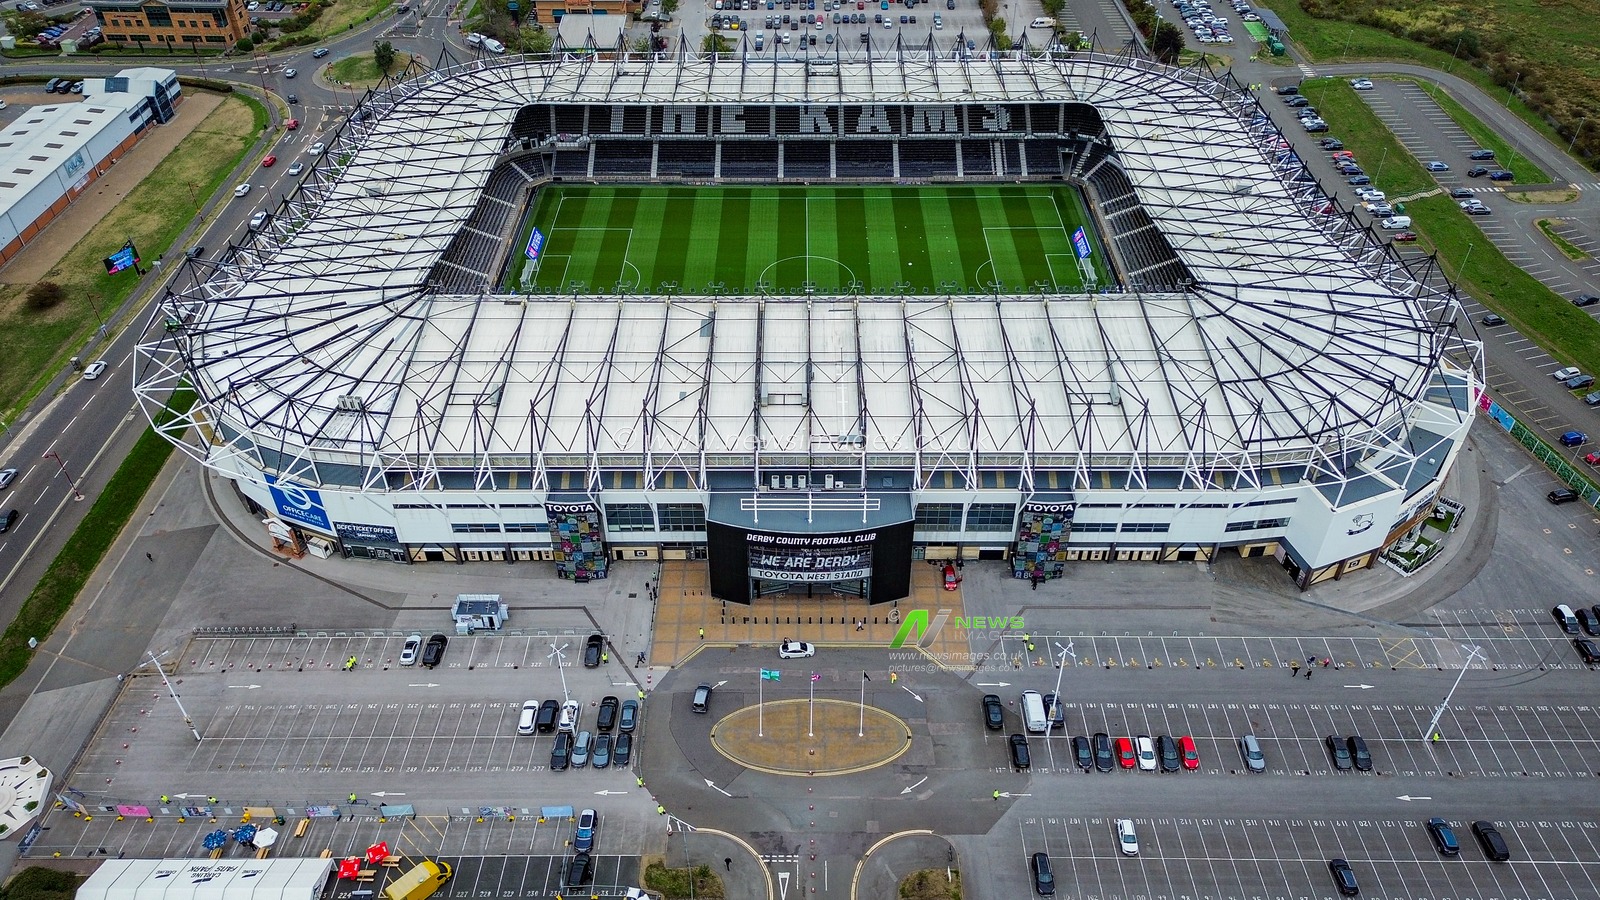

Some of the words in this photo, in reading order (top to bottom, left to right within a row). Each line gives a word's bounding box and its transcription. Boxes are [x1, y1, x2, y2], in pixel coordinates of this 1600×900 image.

[545, 503, 595, 512] TOYOTA
[1026, 503, 1074, 512] TOYOTA
[352, 525, 373, 533] TICKET
[373, 526, 394, 534] OFFICE
[746, 533, 775, 543] DERBY
[776, 536, 810, 545] COUNTY
[811, 535, 853, 545] FOOTBALL
[854, 533, 877, 542] CLUB
[760, 555, 781, 566] WE
[783, 557, 812, 568] ARE
[814, 554, 860, 568] DERBY
[758, 570, 804, 580] TOYOTA
[834, 569, 863, 579] STAND
[1158, 817, 1169, 825] 111
[1404, 820, 1417, 828] 122
[187, 865, 213, 873] PARK
[213, 865, 239, 873] FANS
